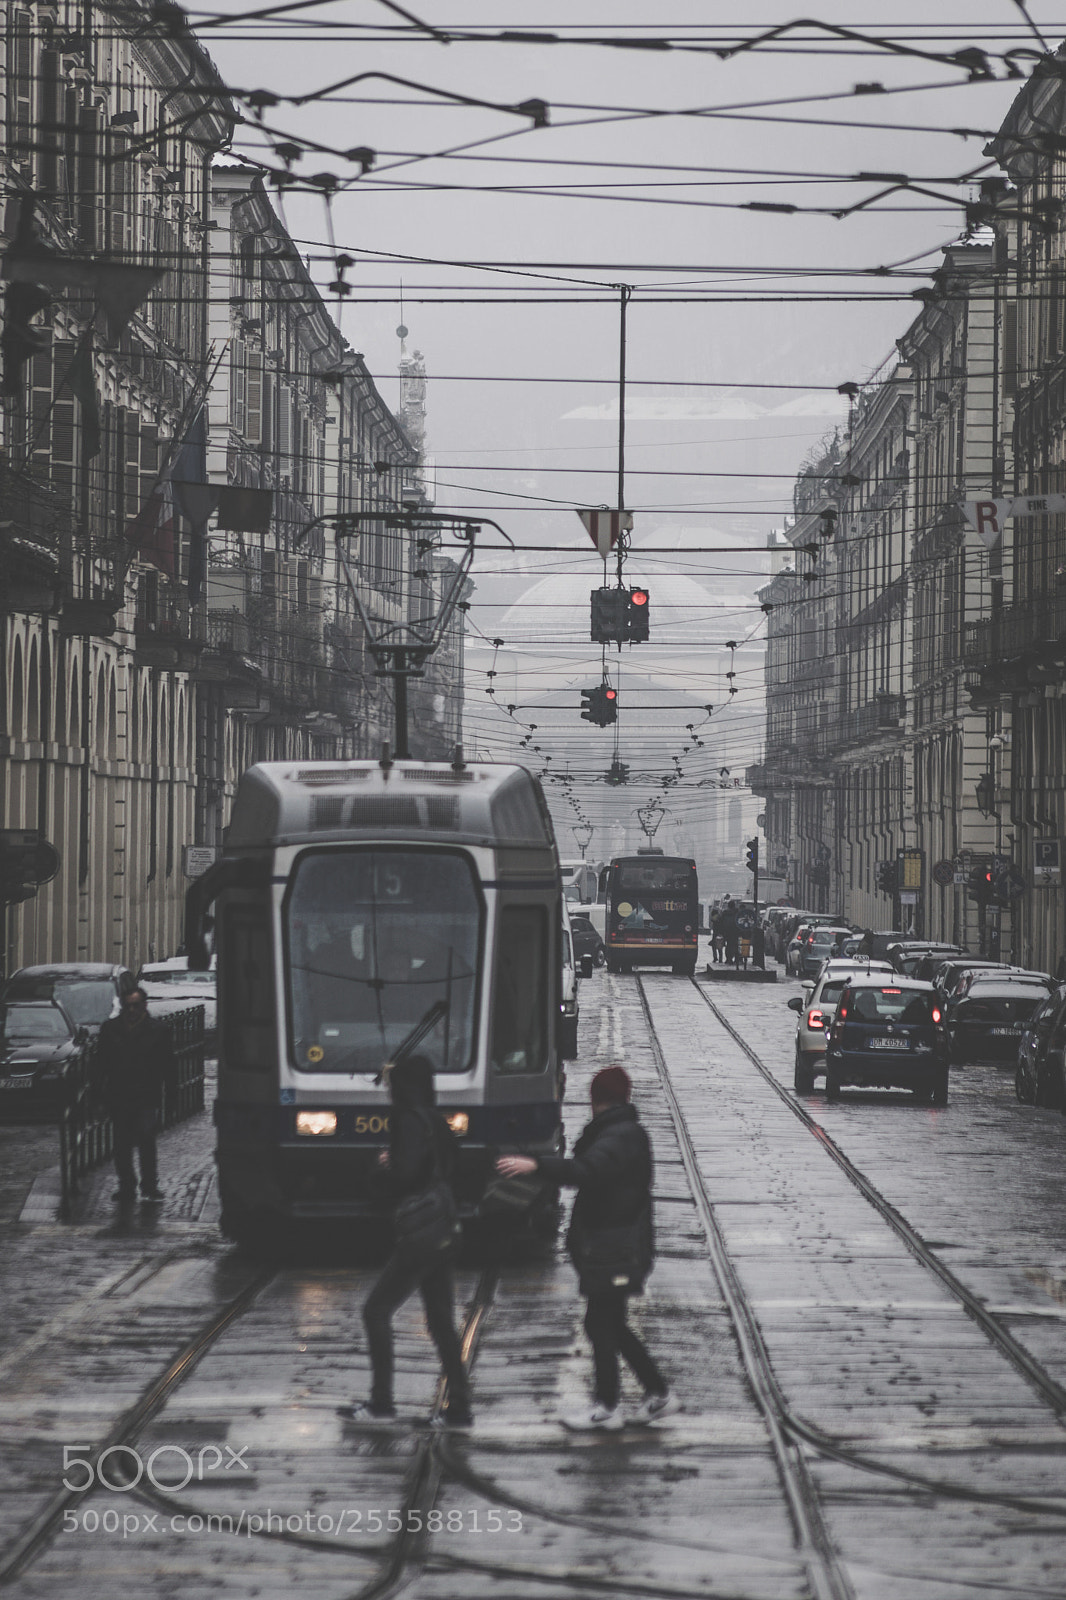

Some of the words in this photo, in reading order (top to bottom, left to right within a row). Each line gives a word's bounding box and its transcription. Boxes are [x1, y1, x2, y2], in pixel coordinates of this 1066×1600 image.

[1027, 500, 1048, 511] FINE
[976, 502, 999, 533] R
[1042, 845, 1052, 858] P
